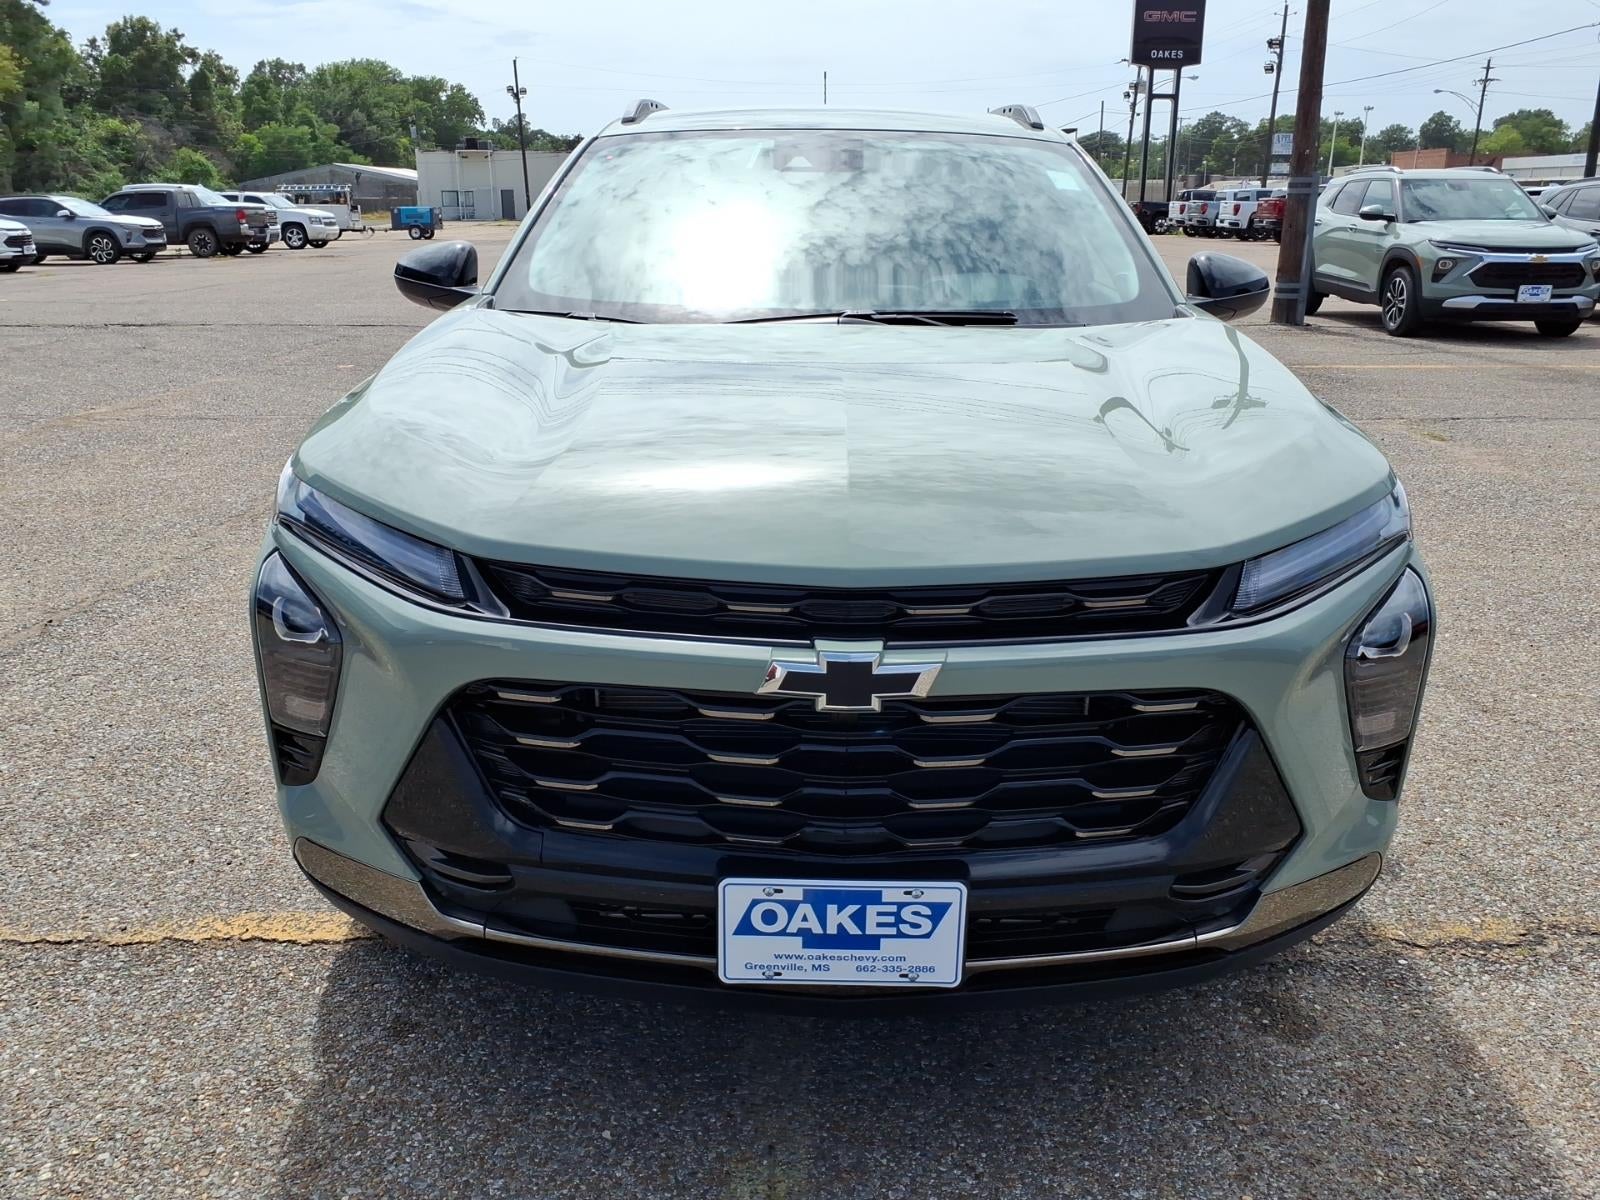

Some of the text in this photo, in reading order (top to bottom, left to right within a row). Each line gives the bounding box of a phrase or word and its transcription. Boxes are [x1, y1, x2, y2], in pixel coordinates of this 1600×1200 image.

[1143, 10, 1197, 22] GMC
[1151, 50, 1184, 59] OAKES
[750, 901, 934, 936] OAKES
[773, 952, 907, 963] www.oakeschevy.com
[744, 962, 936, 973] Greenville, MS 662-335-2886
